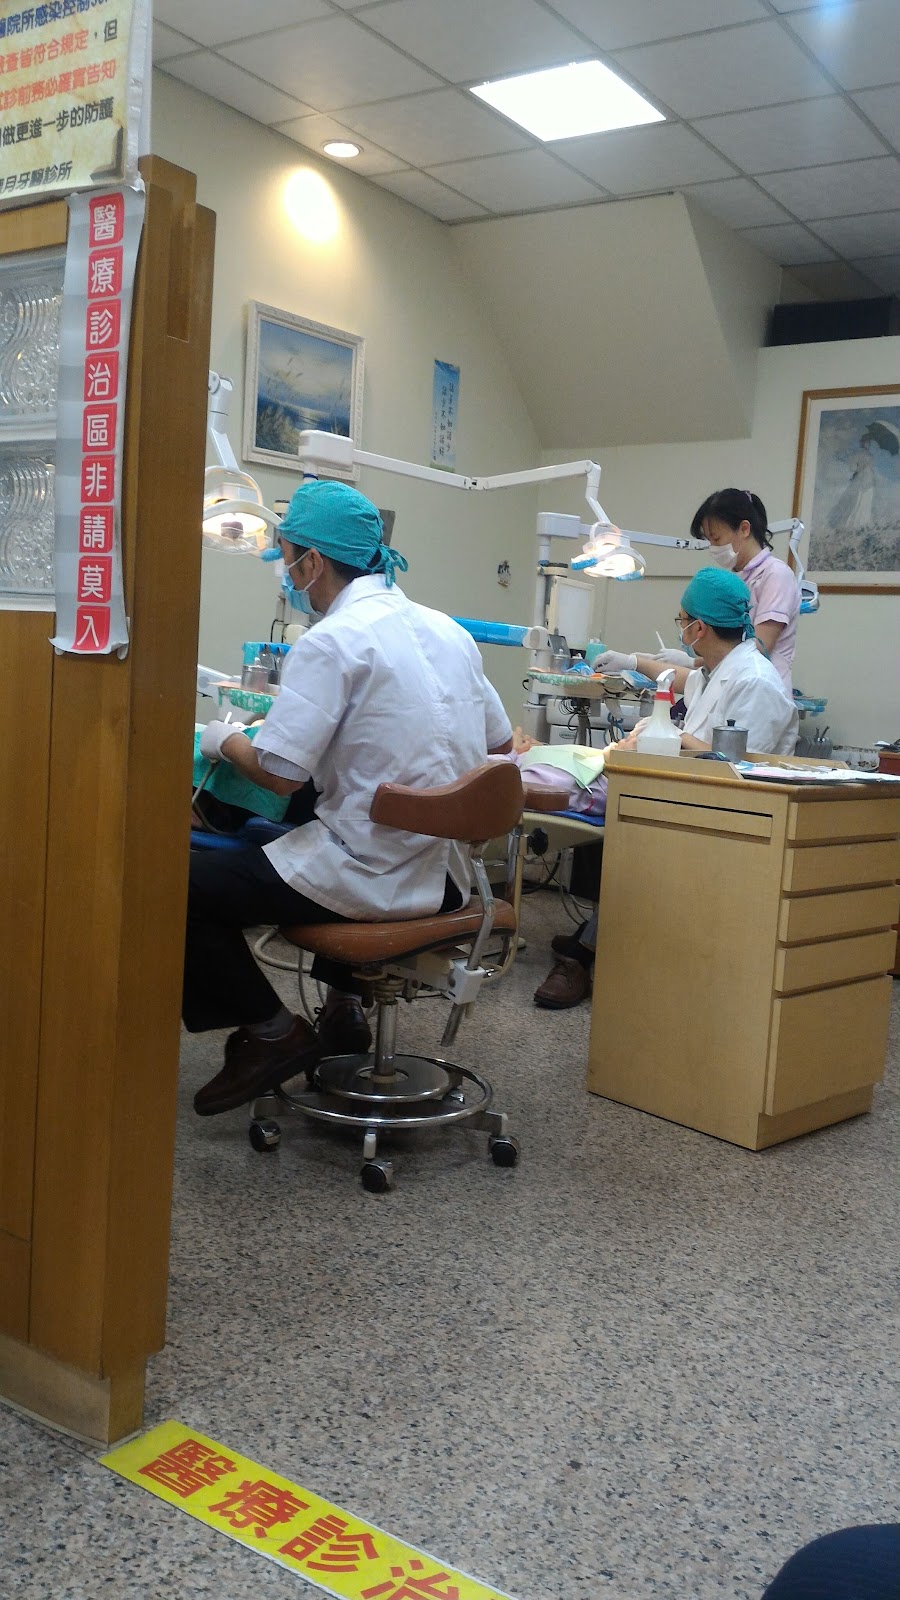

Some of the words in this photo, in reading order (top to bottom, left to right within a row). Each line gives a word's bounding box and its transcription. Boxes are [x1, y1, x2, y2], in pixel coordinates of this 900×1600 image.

[0, 59, 116, 111] 診前務必確實告知
[0, 97, 114, 147] 做更進一步的防護
[0, 161, 73, 194] 月牙醫診所
[76, 204, 120, 649] 醫療診治區非請莫入
